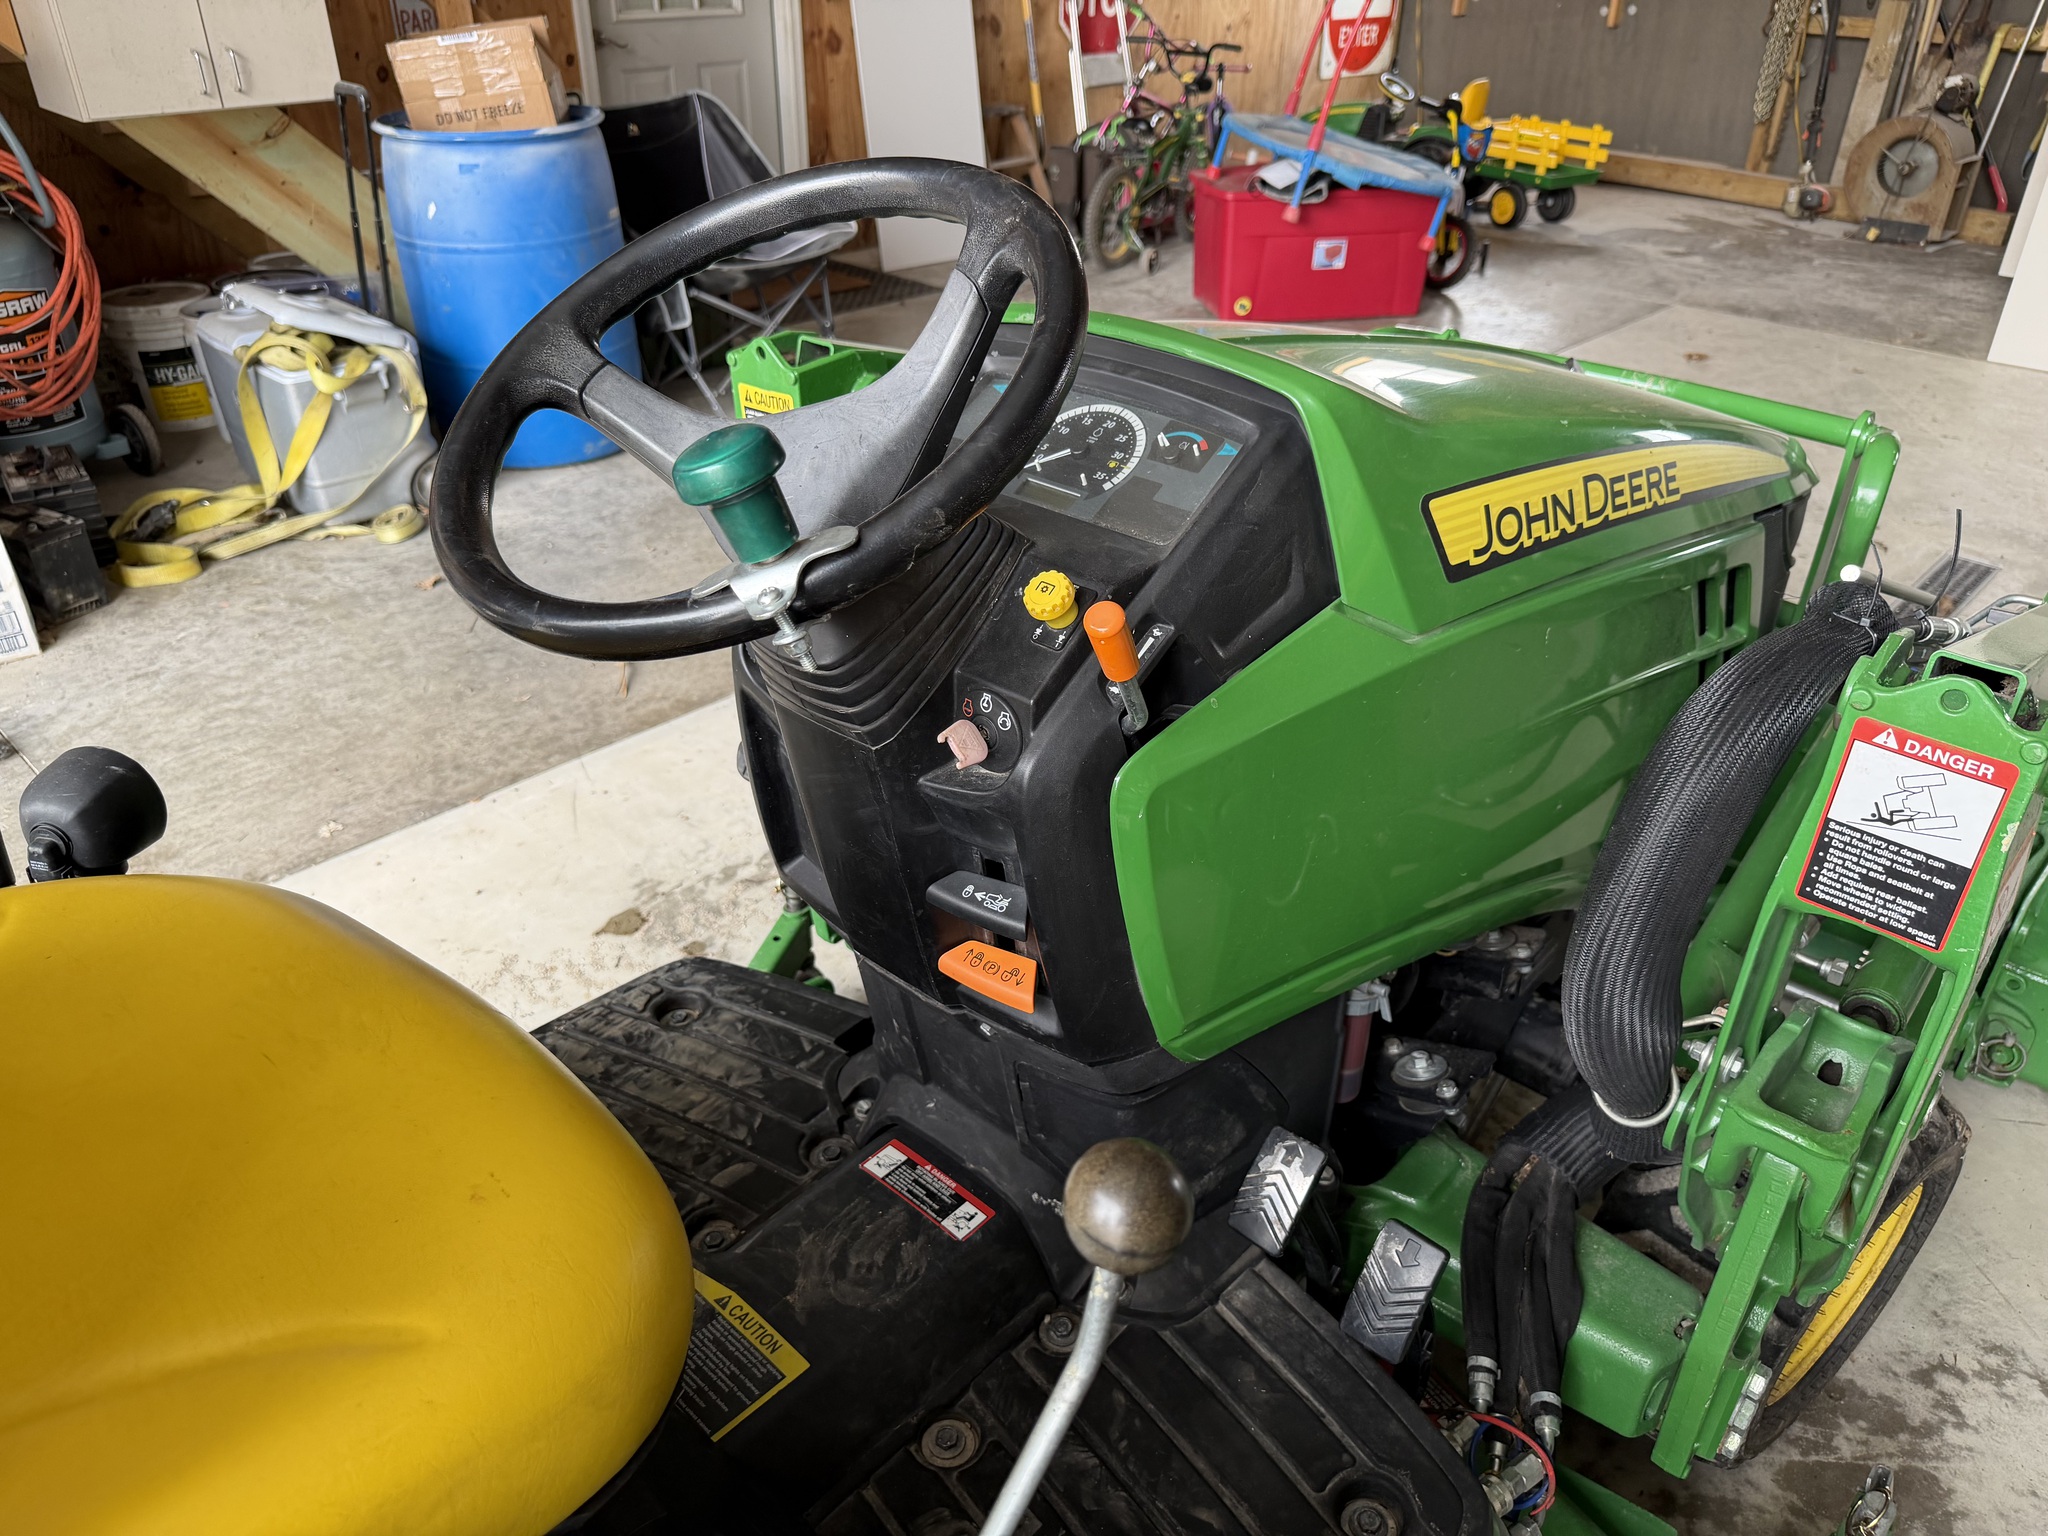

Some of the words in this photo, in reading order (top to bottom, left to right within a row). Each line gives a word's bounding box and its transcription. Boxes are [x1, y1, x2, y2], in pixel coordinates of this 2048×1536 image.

[436, 113, 453, 126] DO
[455, 108, 479, 122] NOT
[483, 102, 525, 119] FREEZE
[754, 392, 791, 410] CAUTION
[1058, 426, 1070, 435] 10
[1082, 417, 1094, 426] 15
[1102, 420, 1116, 428] 20
[1114, 434, 1129, 443] 25
[1110, 451, 1125, 459] 30
[1092, 471, 1106, 480] 35
[1472, 488, 1576, 559] JOHN
[1581, 461, 1681, 522] DEERE
[1904, 739, 1995, 780] DANGER
[1825, 830, 1850, 842] result
[1851, 838, 1872, 850] from
[1873, 847, 1913, 866] rollovers.
[1828, 821, 1860, 838] Serious
[1862, 833, 1887, 848] injury
[1900, 848, 1926, 862] death
[1927, 859, 1945, 868] can
[1828, 847, 1857, 862] square
[1859, 857, 1884, 872] bales.
[1826, 853, 1843, 864] Use
[1868, 871, 1886, 880] and
[1886, 877, 1923, 894] seatbelt
[1924, 891, 1934, 899] at
[1831, 839, 1844, 848] Do
[1845, 845, 1860, 854] not
[1861, 850, 1891, 866] handle
[1892, 863, 1919, 876] round
[1932, 876, 1955, 889] large
[1835, 865, 1860, 879] times.
[1815, 883, 1876, 910] recommended
[1877, 907, 1909, 923] setting.
[1818, 875, 1841, 888] Move
[1843, 885, 1872, 900] wheels
[1874, 897, 1883, 905] to
[1886, 902, 1915, 917] widest
[1820, 868, 1838, 879] Add
[1839, 876, 1875, 893] required
[1876, 890, 1895, 900] rear
[1895, 896, 1927, 913] ballast.
[1813, 889, 1846, 906] Operate
[1848, 903, 1877, 918] tractor
[1889, 918, 1906, 929] low
[1907, 927, 1935, 941] speed.
[931, 1168, 957, 1189] DANGER
[729, 1305, 783, 1355] CAUTION
